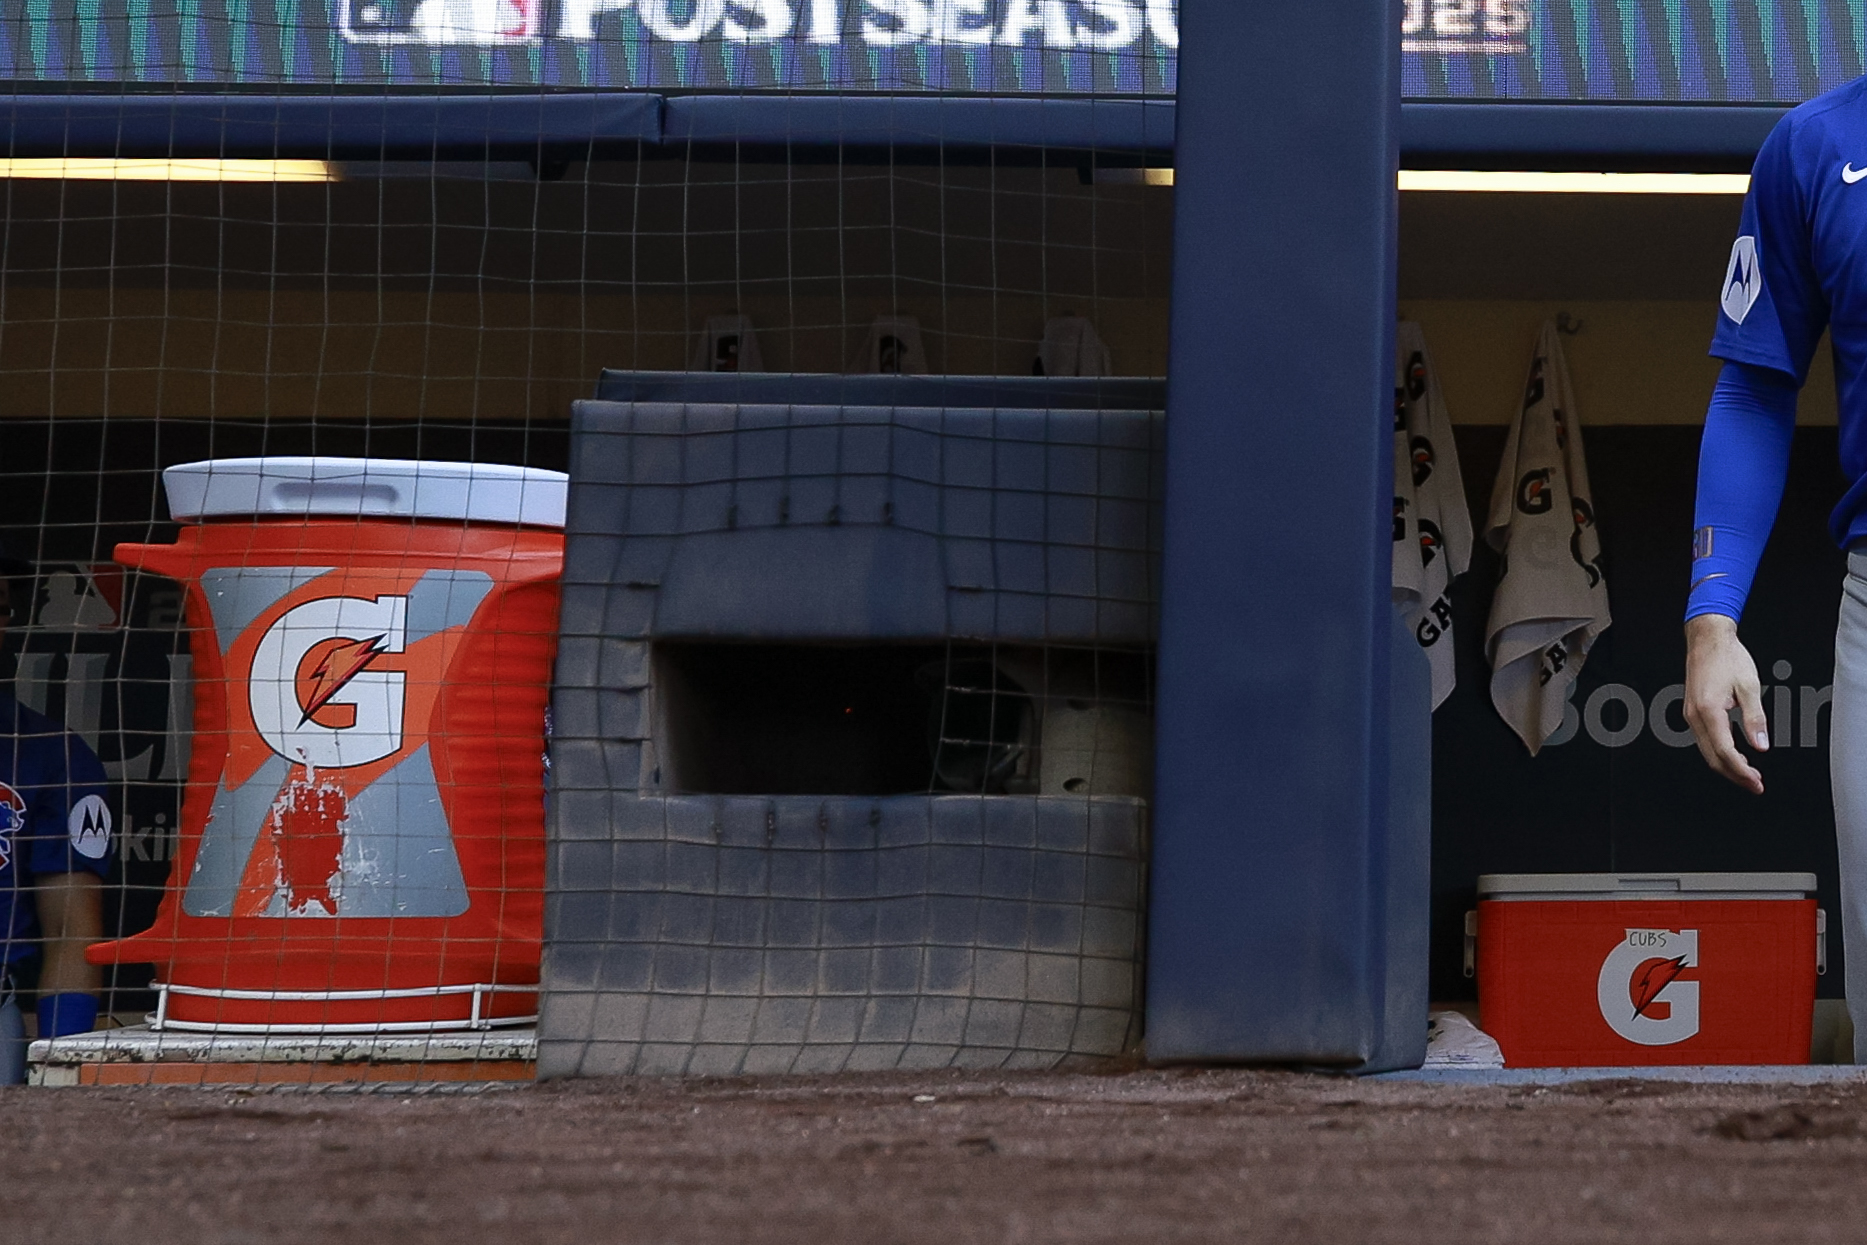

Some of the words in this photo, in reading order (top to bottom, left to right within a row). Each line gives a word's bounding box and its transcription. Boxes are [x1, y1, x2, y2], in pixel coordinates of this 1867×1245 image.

[248, 594, 408, 768] G
[1597, 929, 1700, 1046] G
[1628, 930, 1668, 948] CUBS
